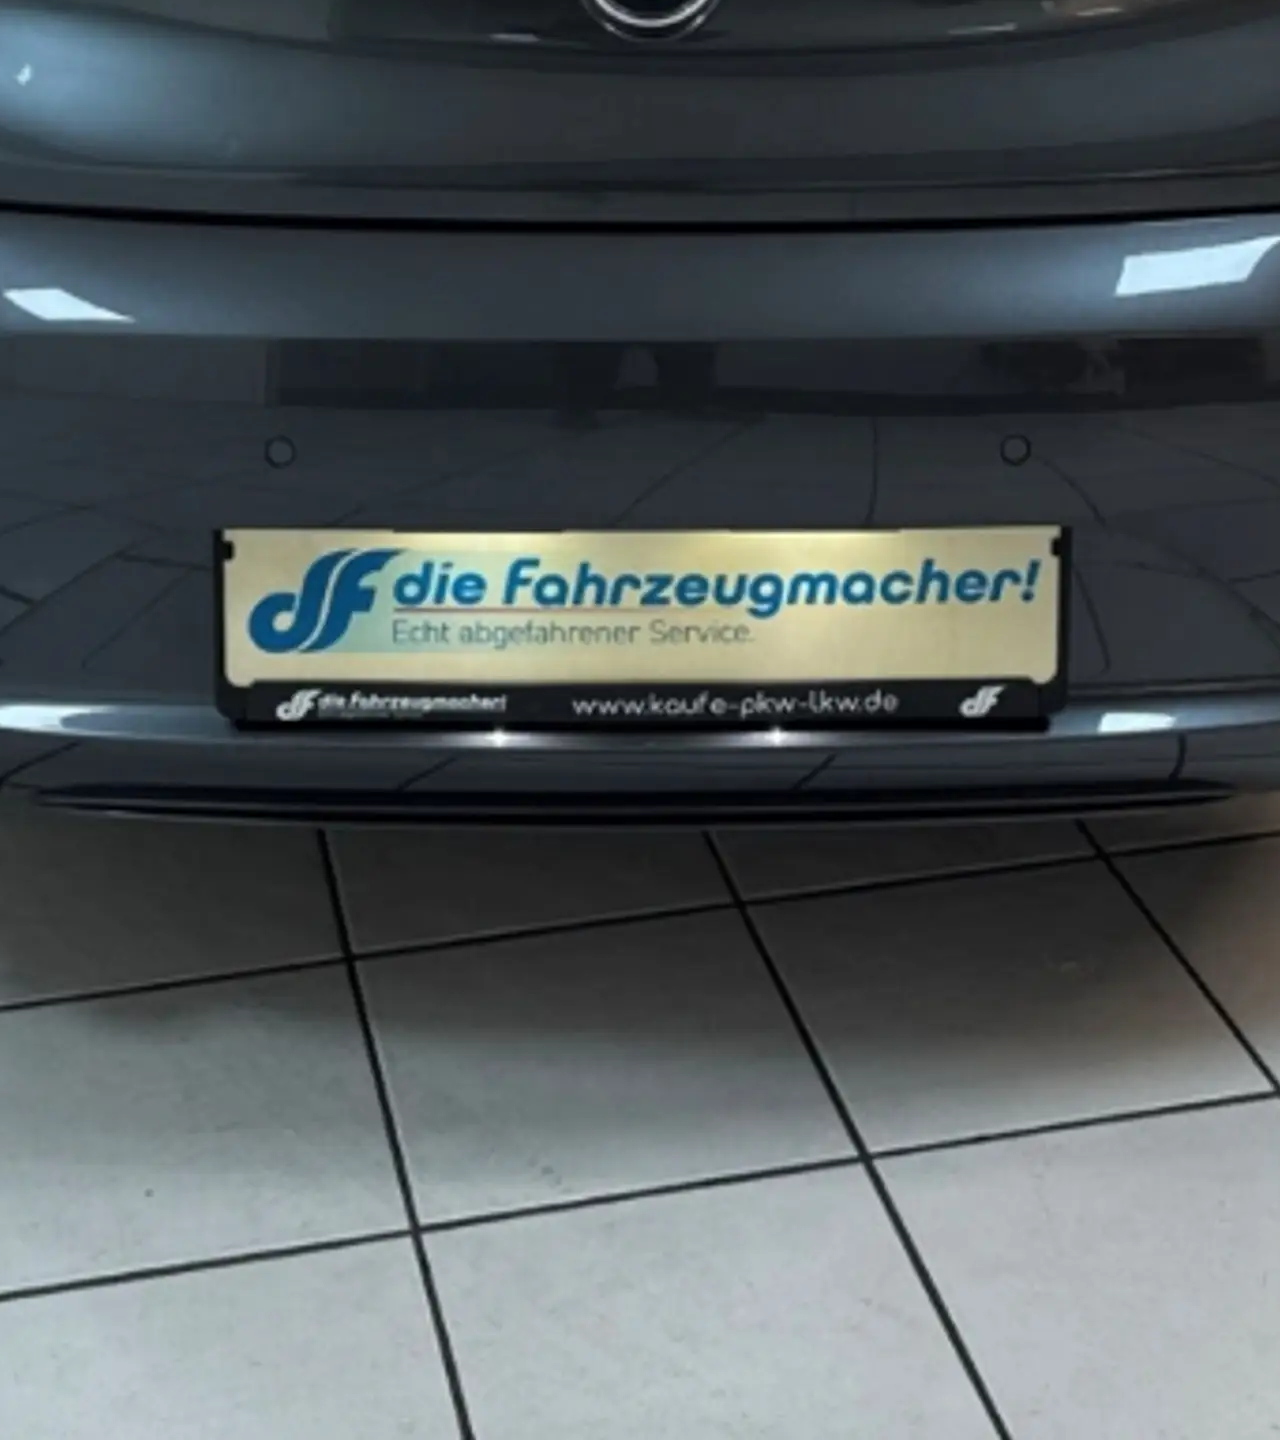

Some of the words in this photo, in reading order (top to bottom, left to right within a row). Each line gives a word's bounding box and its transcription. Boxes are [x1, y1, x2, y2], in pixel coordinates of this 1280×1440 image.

[393, 560, 486, 606] die
[503, 557, 1041, 620] Fahrzeugmacher!
[392, 619, 450, 645] Echt
[459, 619, 640, 650] abgefahrener
[649, 619, 755, 645] Service.
[572, 689, 900, 718] www.kaufe-pkw-lkw.de
